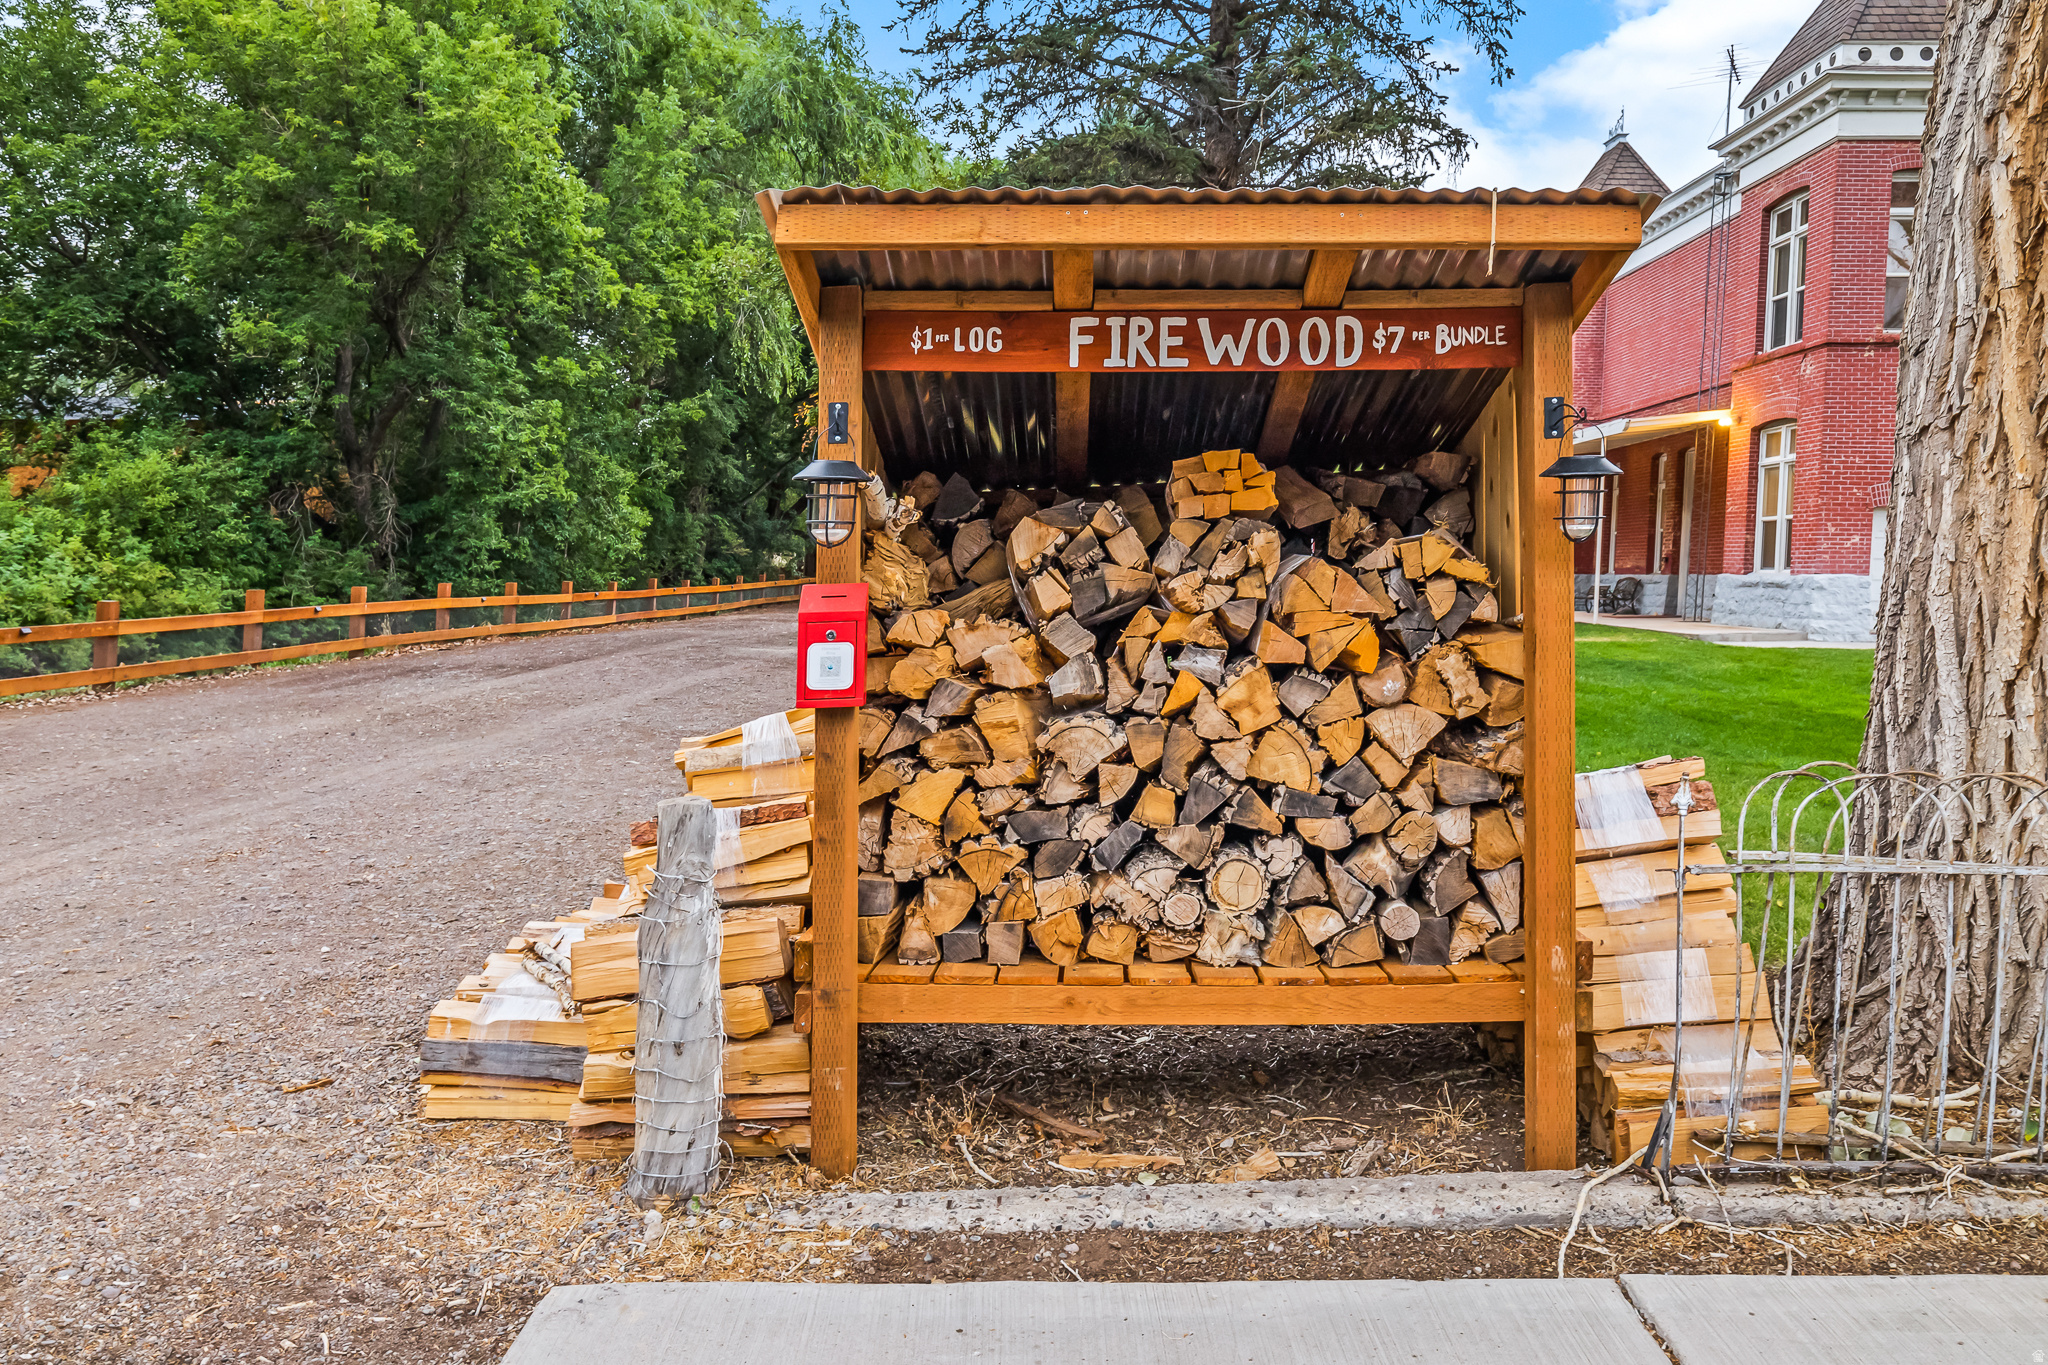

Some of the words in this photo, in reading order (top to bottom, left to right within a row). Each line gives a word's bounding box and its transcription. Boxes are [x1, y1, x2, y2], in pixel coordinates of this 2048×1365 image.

[910, 325, 934, 354] $1
[935, 332, 950, 343] PER
[953, 326, 1003, 353] LOG
[1372, 321, 1406, 355] $7
[1412, 330, 1431, 341] PER
[1435, 323, 1508, 355] BUNDLE
